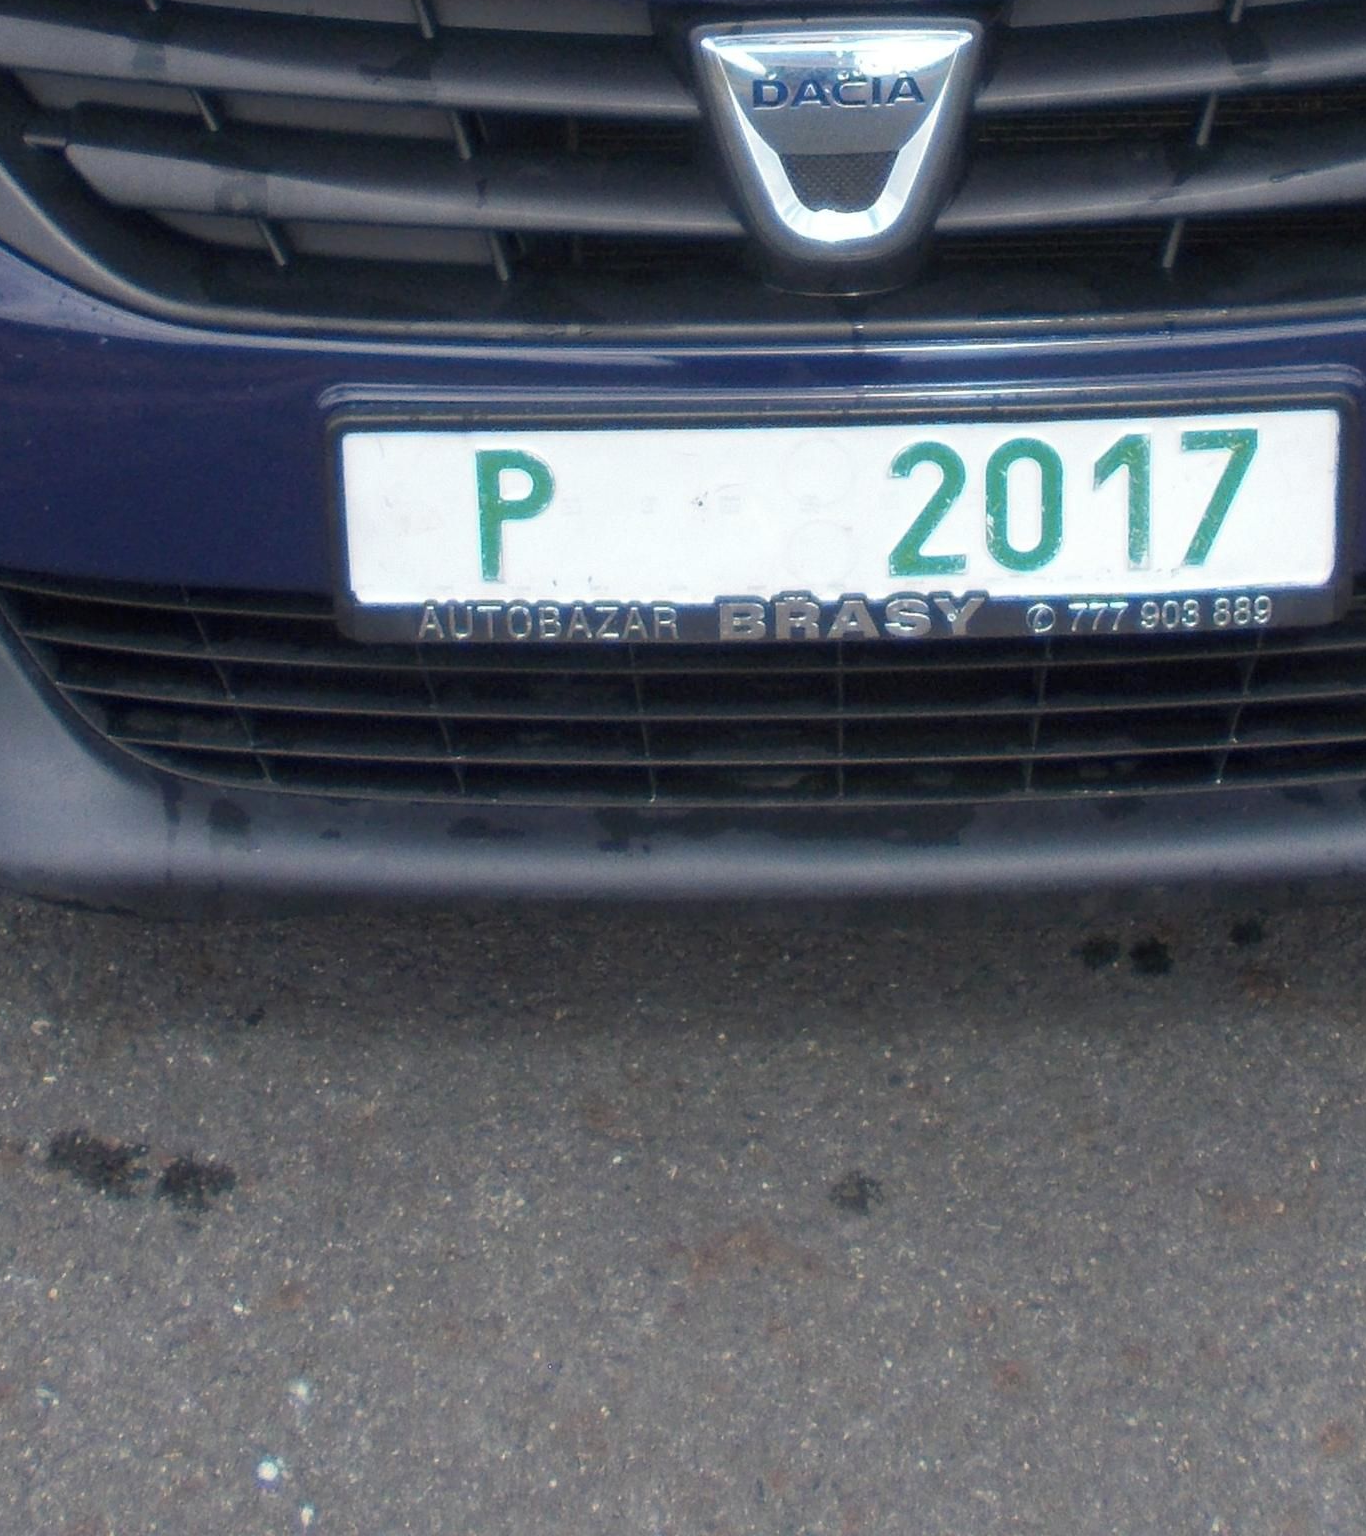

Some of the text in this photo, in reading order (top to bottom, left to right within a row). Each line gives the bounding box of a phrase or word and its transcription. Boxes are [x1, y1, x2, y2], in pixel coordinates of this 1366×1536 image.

[752, 75, 925, 110] DACIA
[475, 428, 1259, 583] P 2017
[418, 603, 680, 641] AUTOBAZAR
[1068, 600, 1129, 632] 777
[1140, 598, 1201, 630] 903
[1213, 594, 1273, 627] 889
